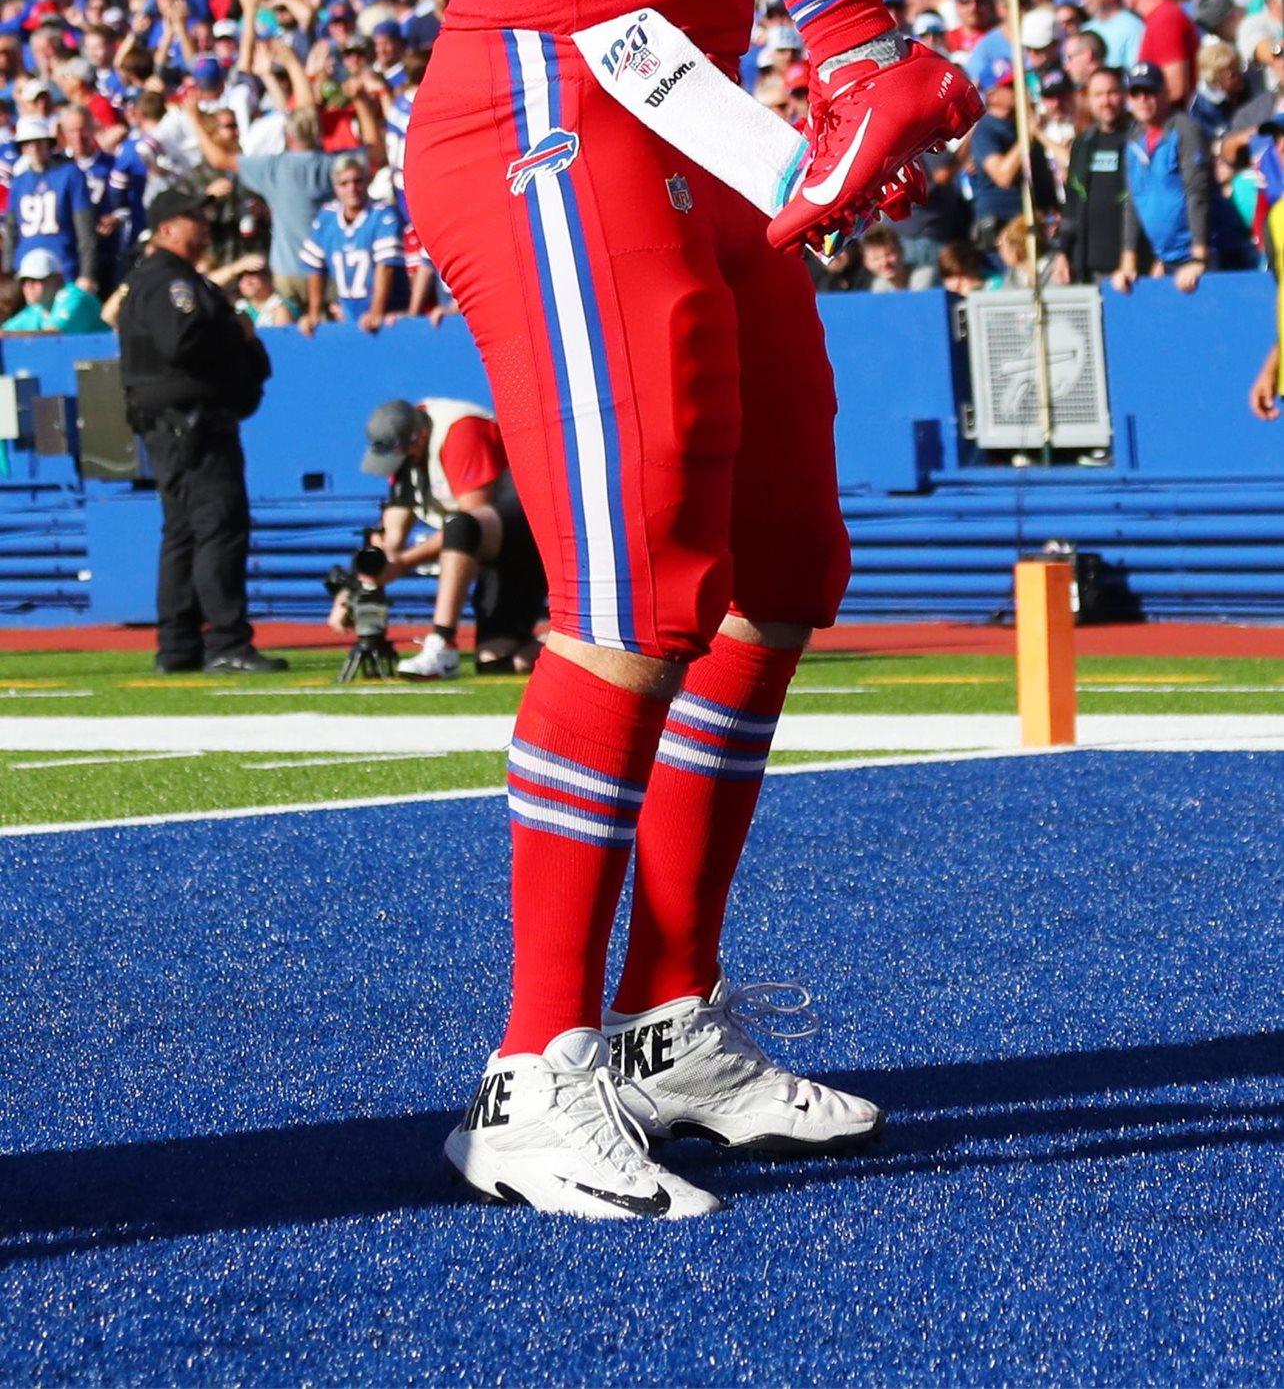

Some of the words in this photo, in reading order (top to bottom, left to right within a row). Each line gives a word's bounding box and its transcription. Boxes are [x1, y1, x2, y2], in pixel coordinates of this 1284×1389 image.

[638, 58, 659, 77] NFL
[644, 63, 691, 108] Wilson
[19, 189, 60, 239] 91
[332, 249, 370, 299] 17
[607, 1019, 675, 1084] IKE
